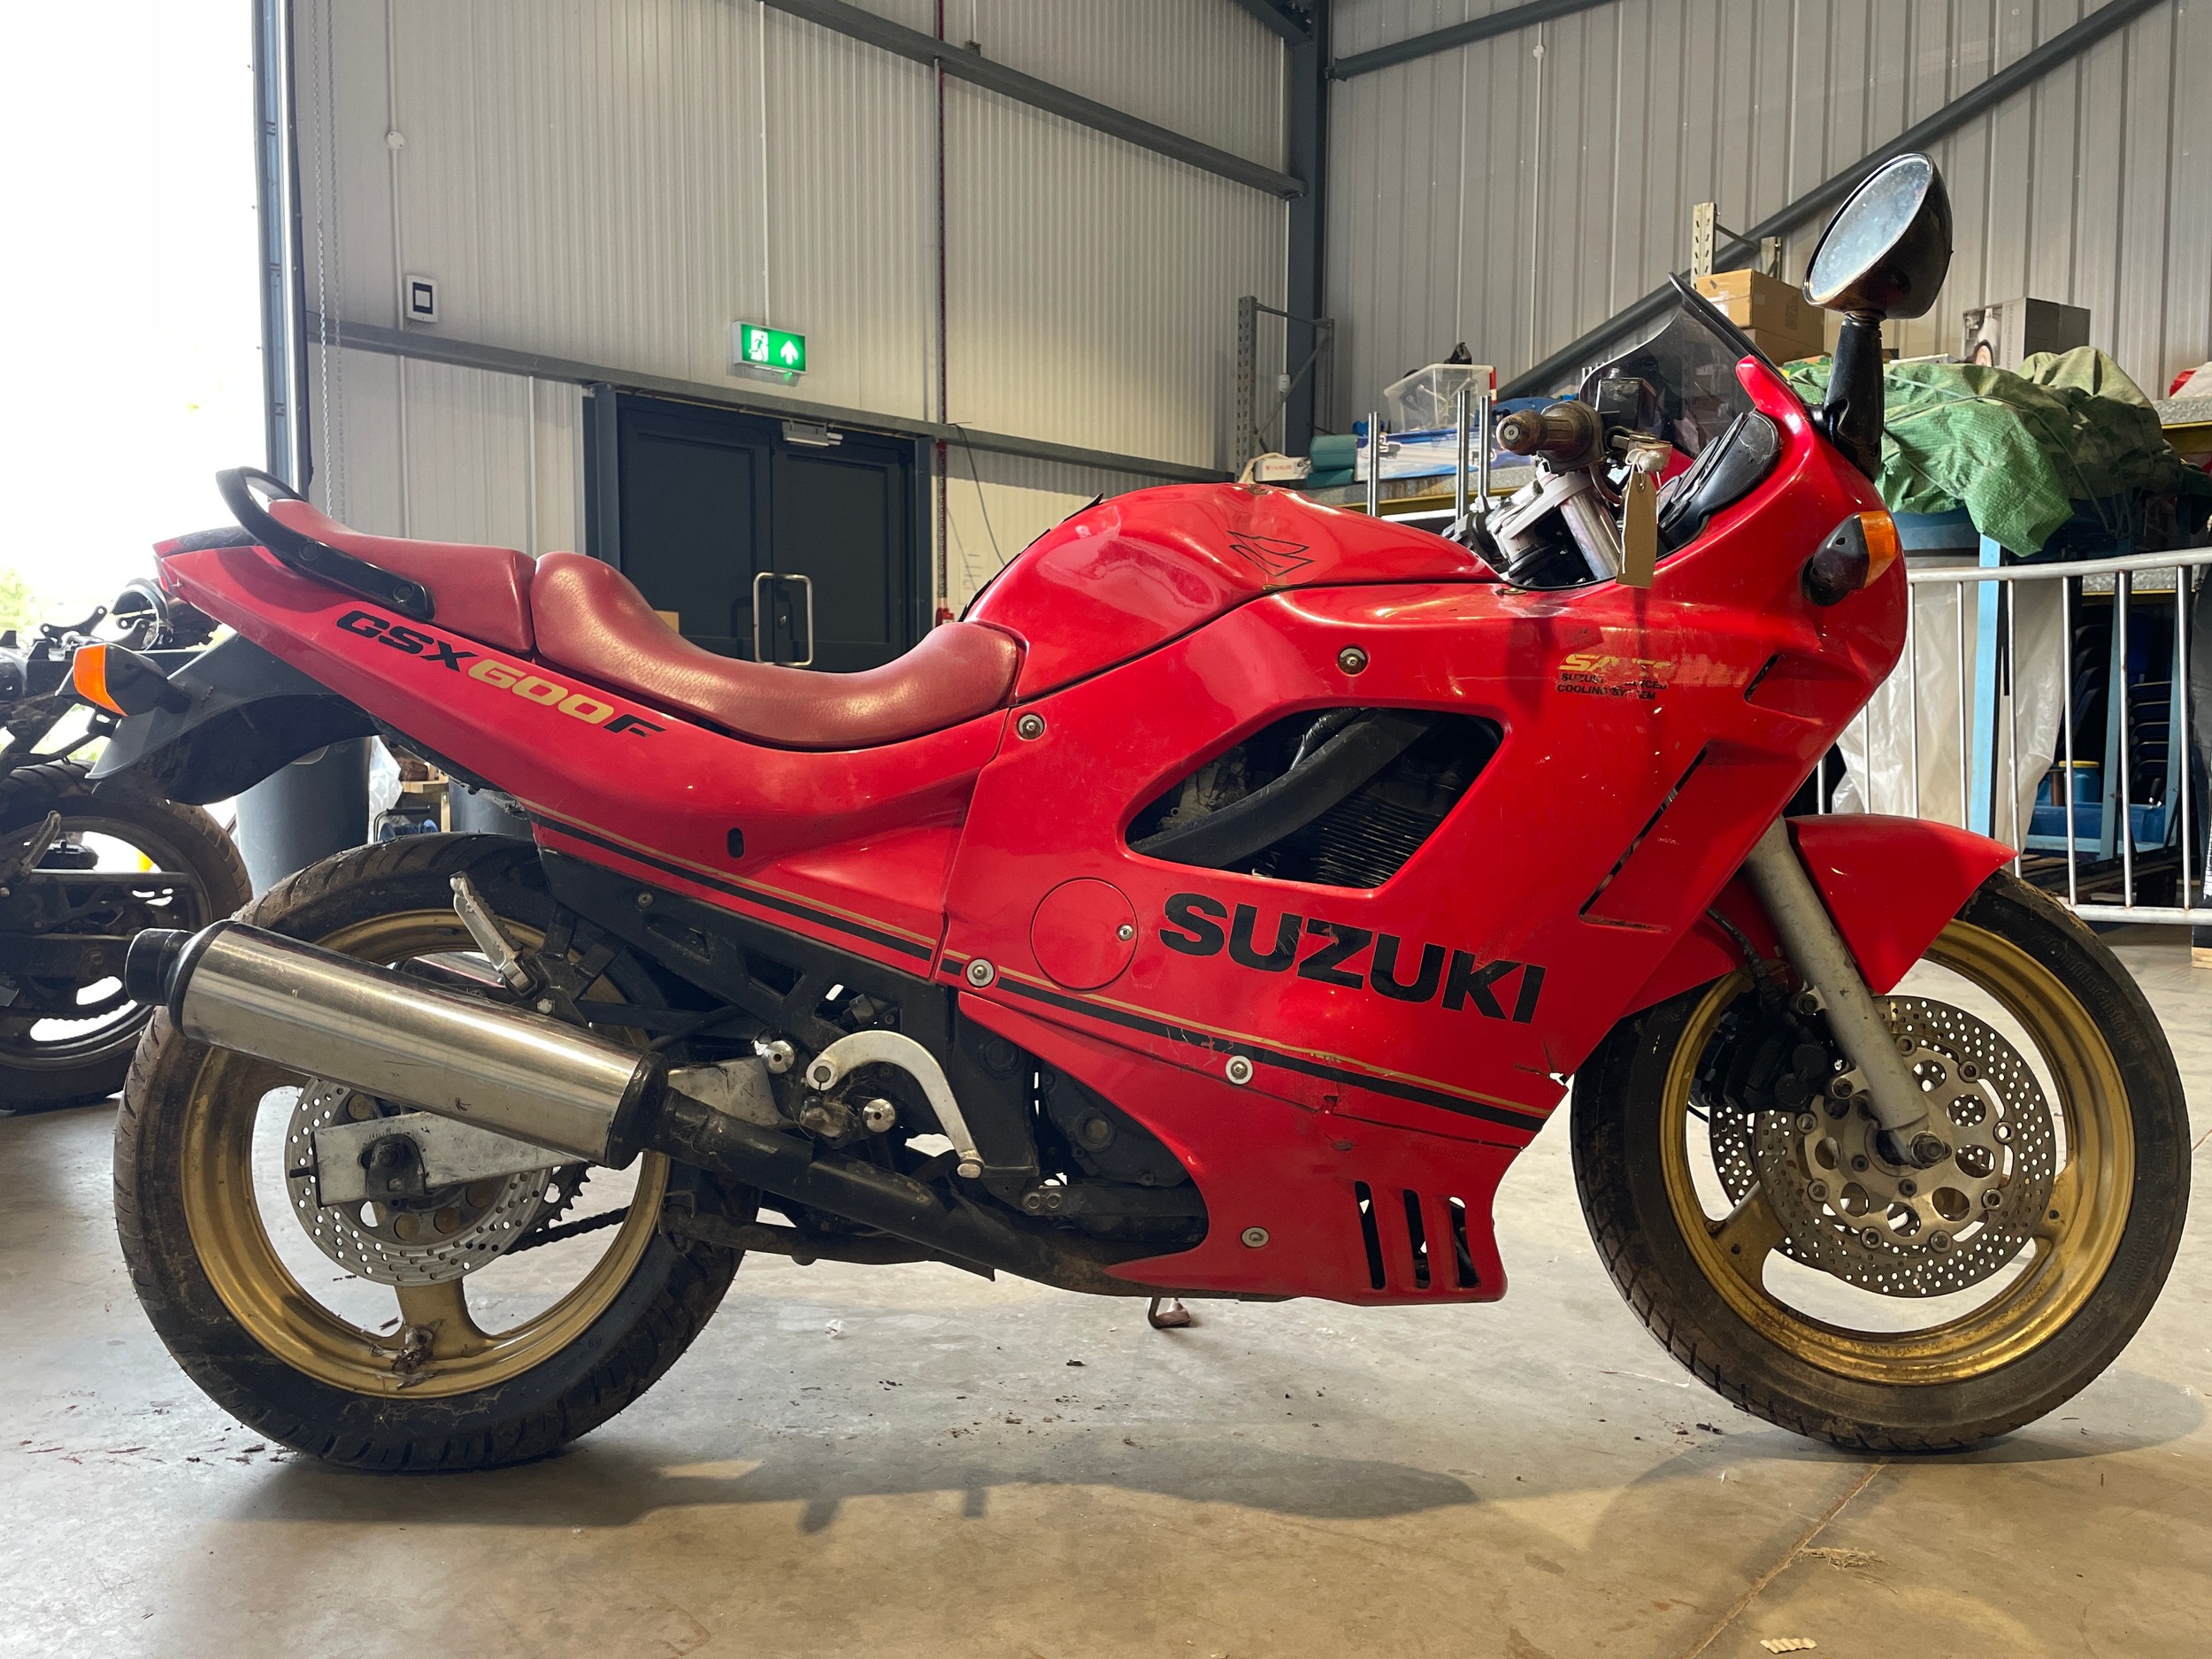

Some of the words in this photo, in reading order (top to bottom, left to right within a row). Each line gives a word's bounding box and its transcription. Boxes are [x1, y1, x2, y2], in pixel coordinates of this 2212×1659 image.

[336, 610, 666, 738] GSX600F
[1557, 683, 1608, 695] COOLING
[1610, 685, 1656, 700] SYEM
[1558, 653, 1671, 678] SA
[1158, 893, 1546, 1025] SUZUKI
